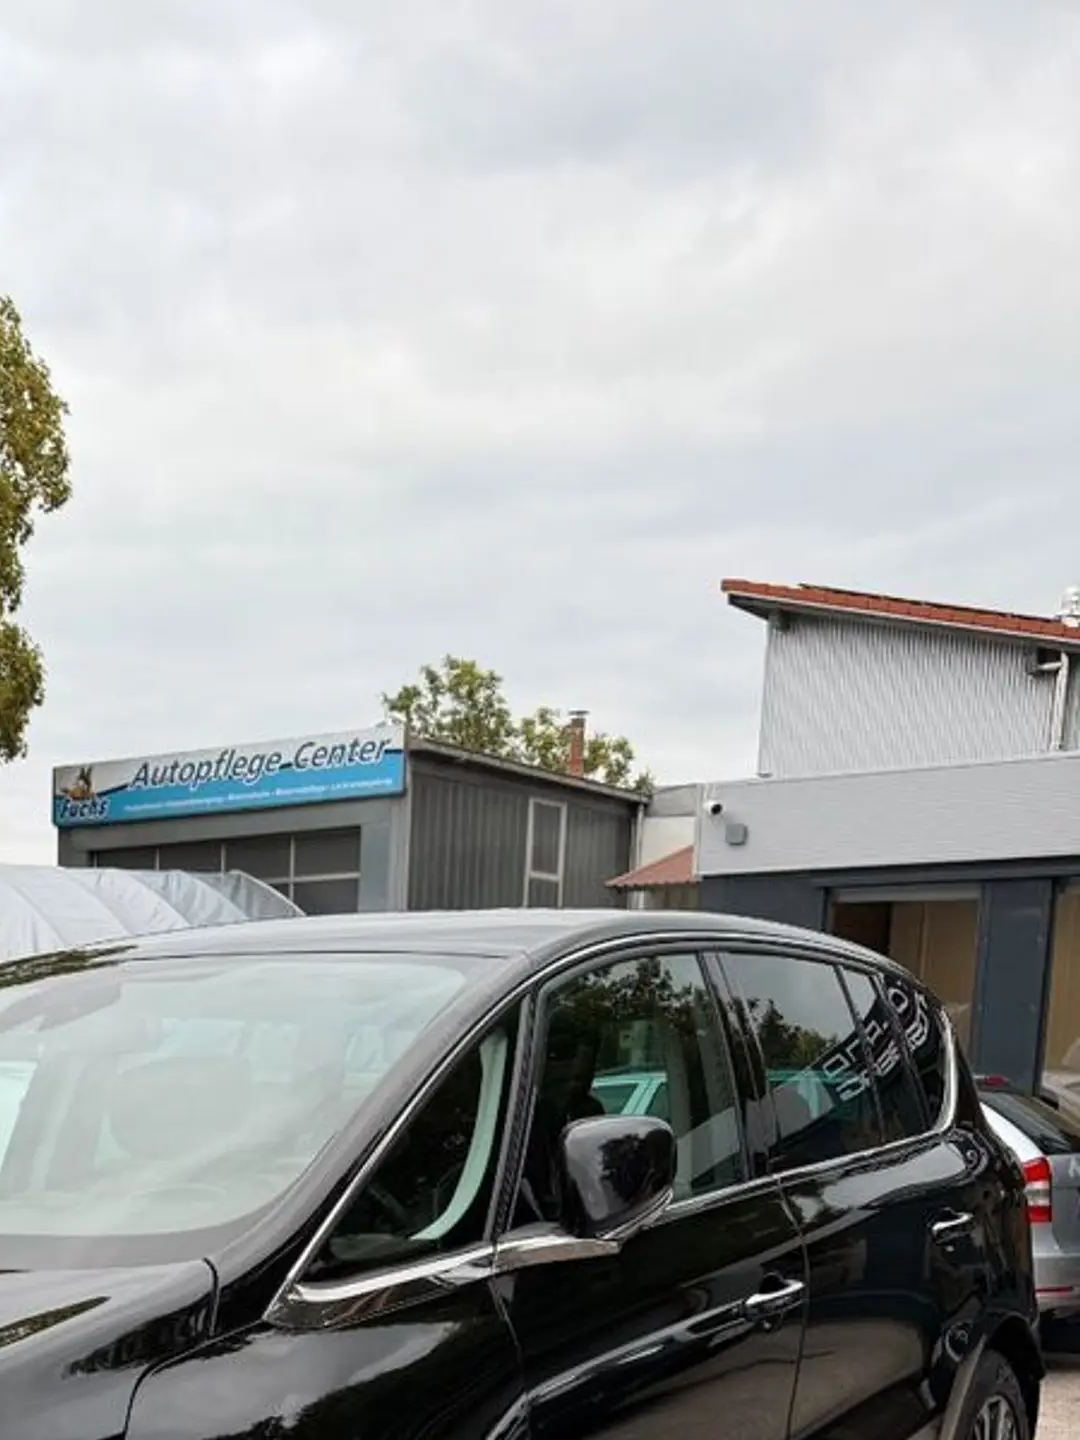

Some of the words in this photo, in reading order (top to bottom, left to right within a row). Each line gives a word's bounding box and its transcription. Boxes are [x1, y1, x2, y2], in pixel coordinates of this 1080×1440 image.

[132, 749, 282, 789] Autopflege
[295, 737, 391, 769] Center
[58, 797, 108, 819] Fuchs
